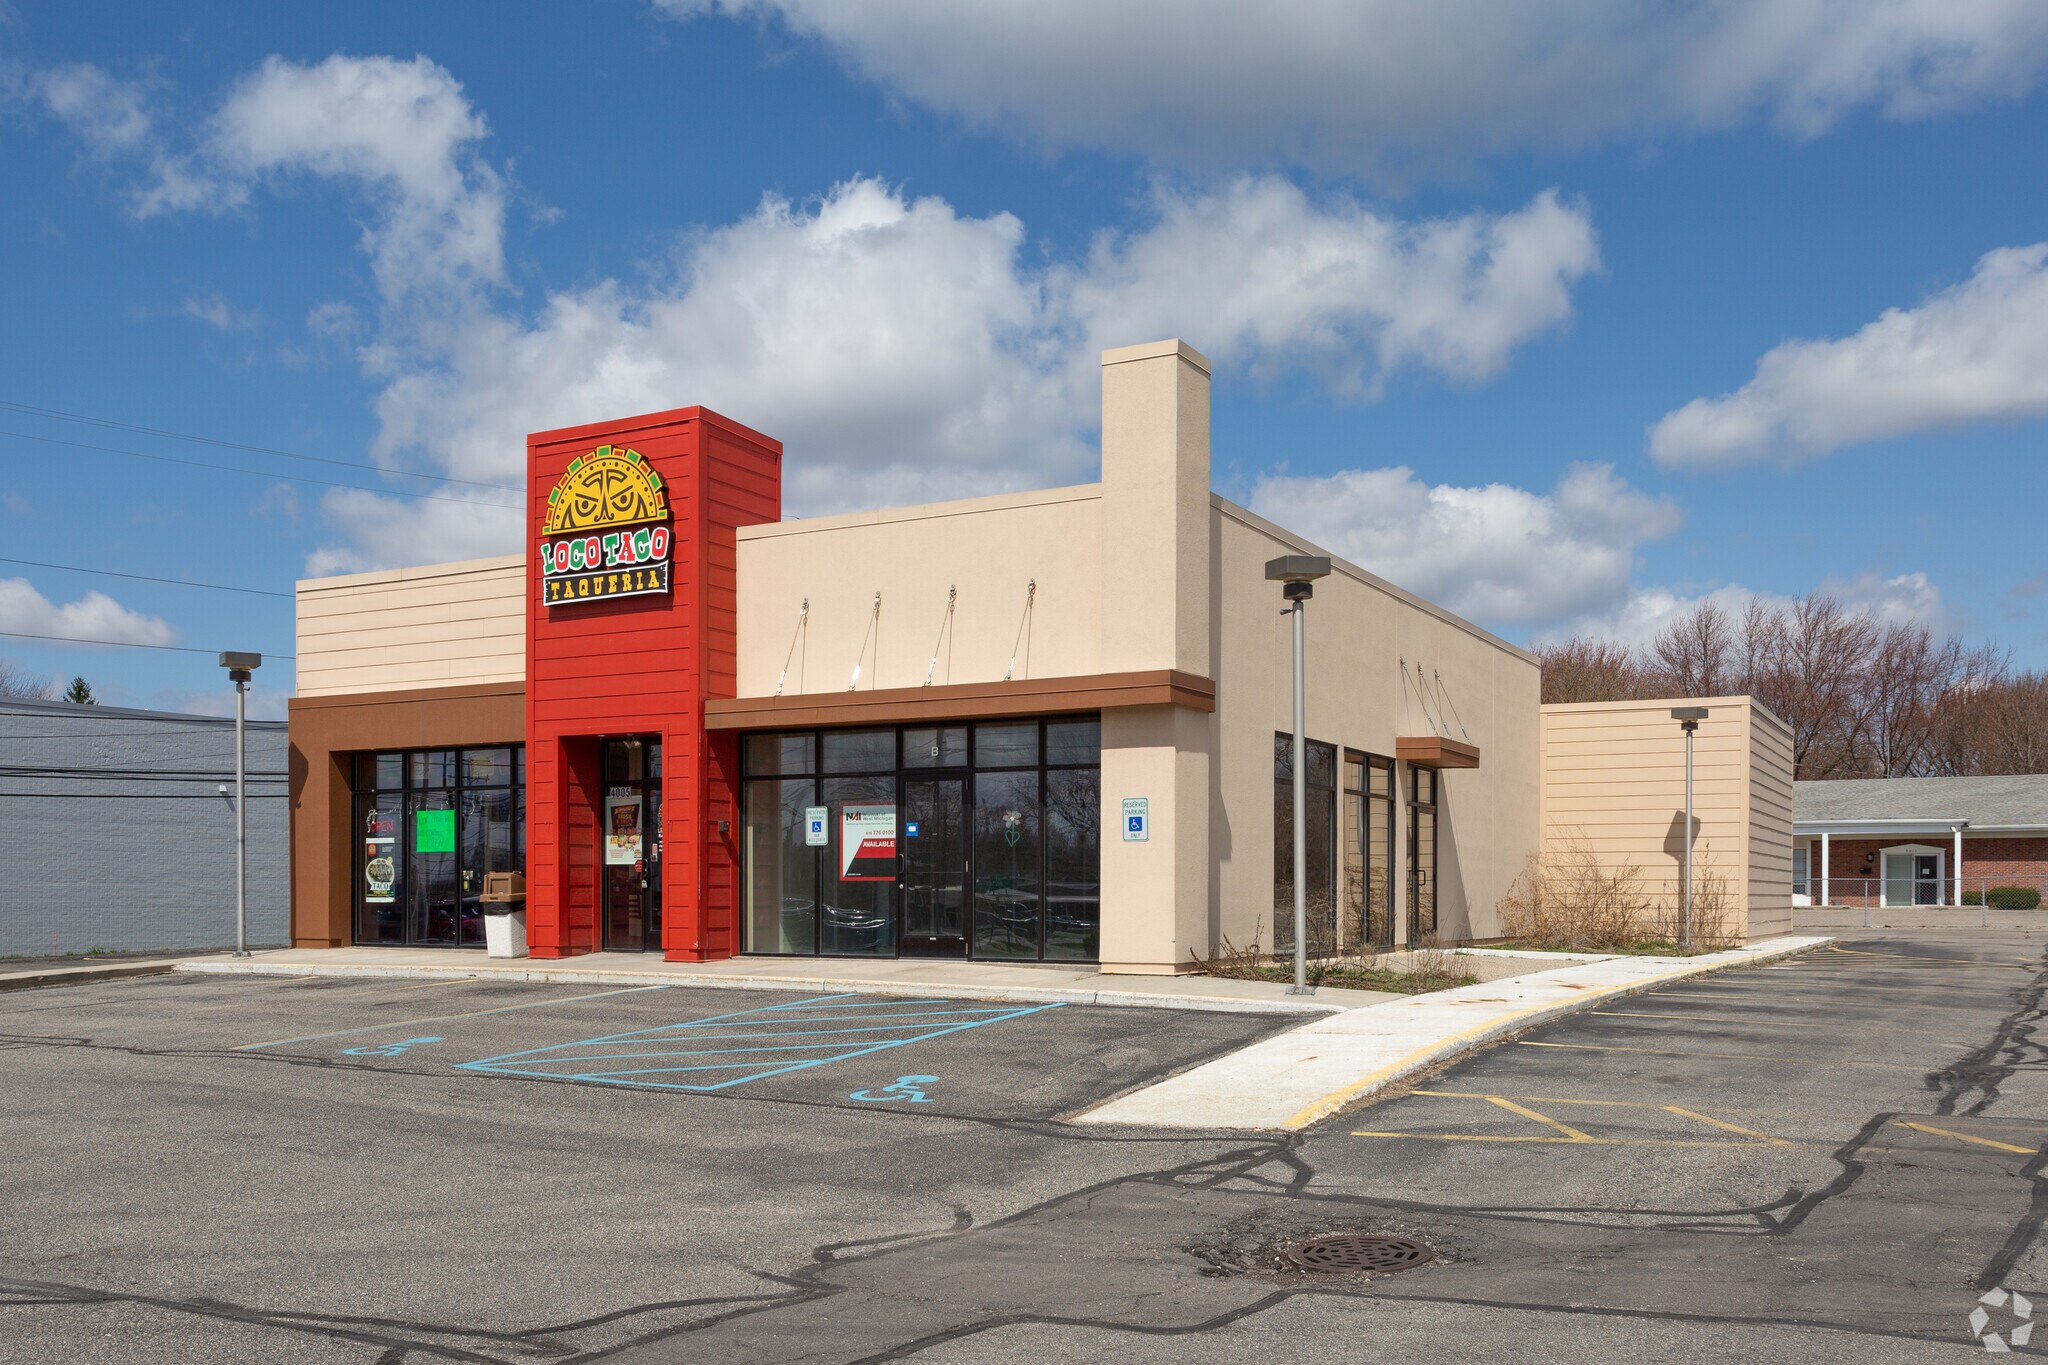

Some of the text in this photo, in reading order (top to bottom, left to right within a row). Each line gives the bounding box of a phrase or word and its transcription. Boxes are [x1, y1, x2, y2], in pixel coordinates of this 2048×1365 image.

[541, 527, 669, 575] LOCO TACO
[551, 570, 660, 600] TAQUERIA
[931, 746, 939, 757] B
[610, 787, 631, 798] 4005
[846, 811, 862, 821] NAI
[370, 821, 393, 832] OPEN
[373, 882, 389, 890] TACO
